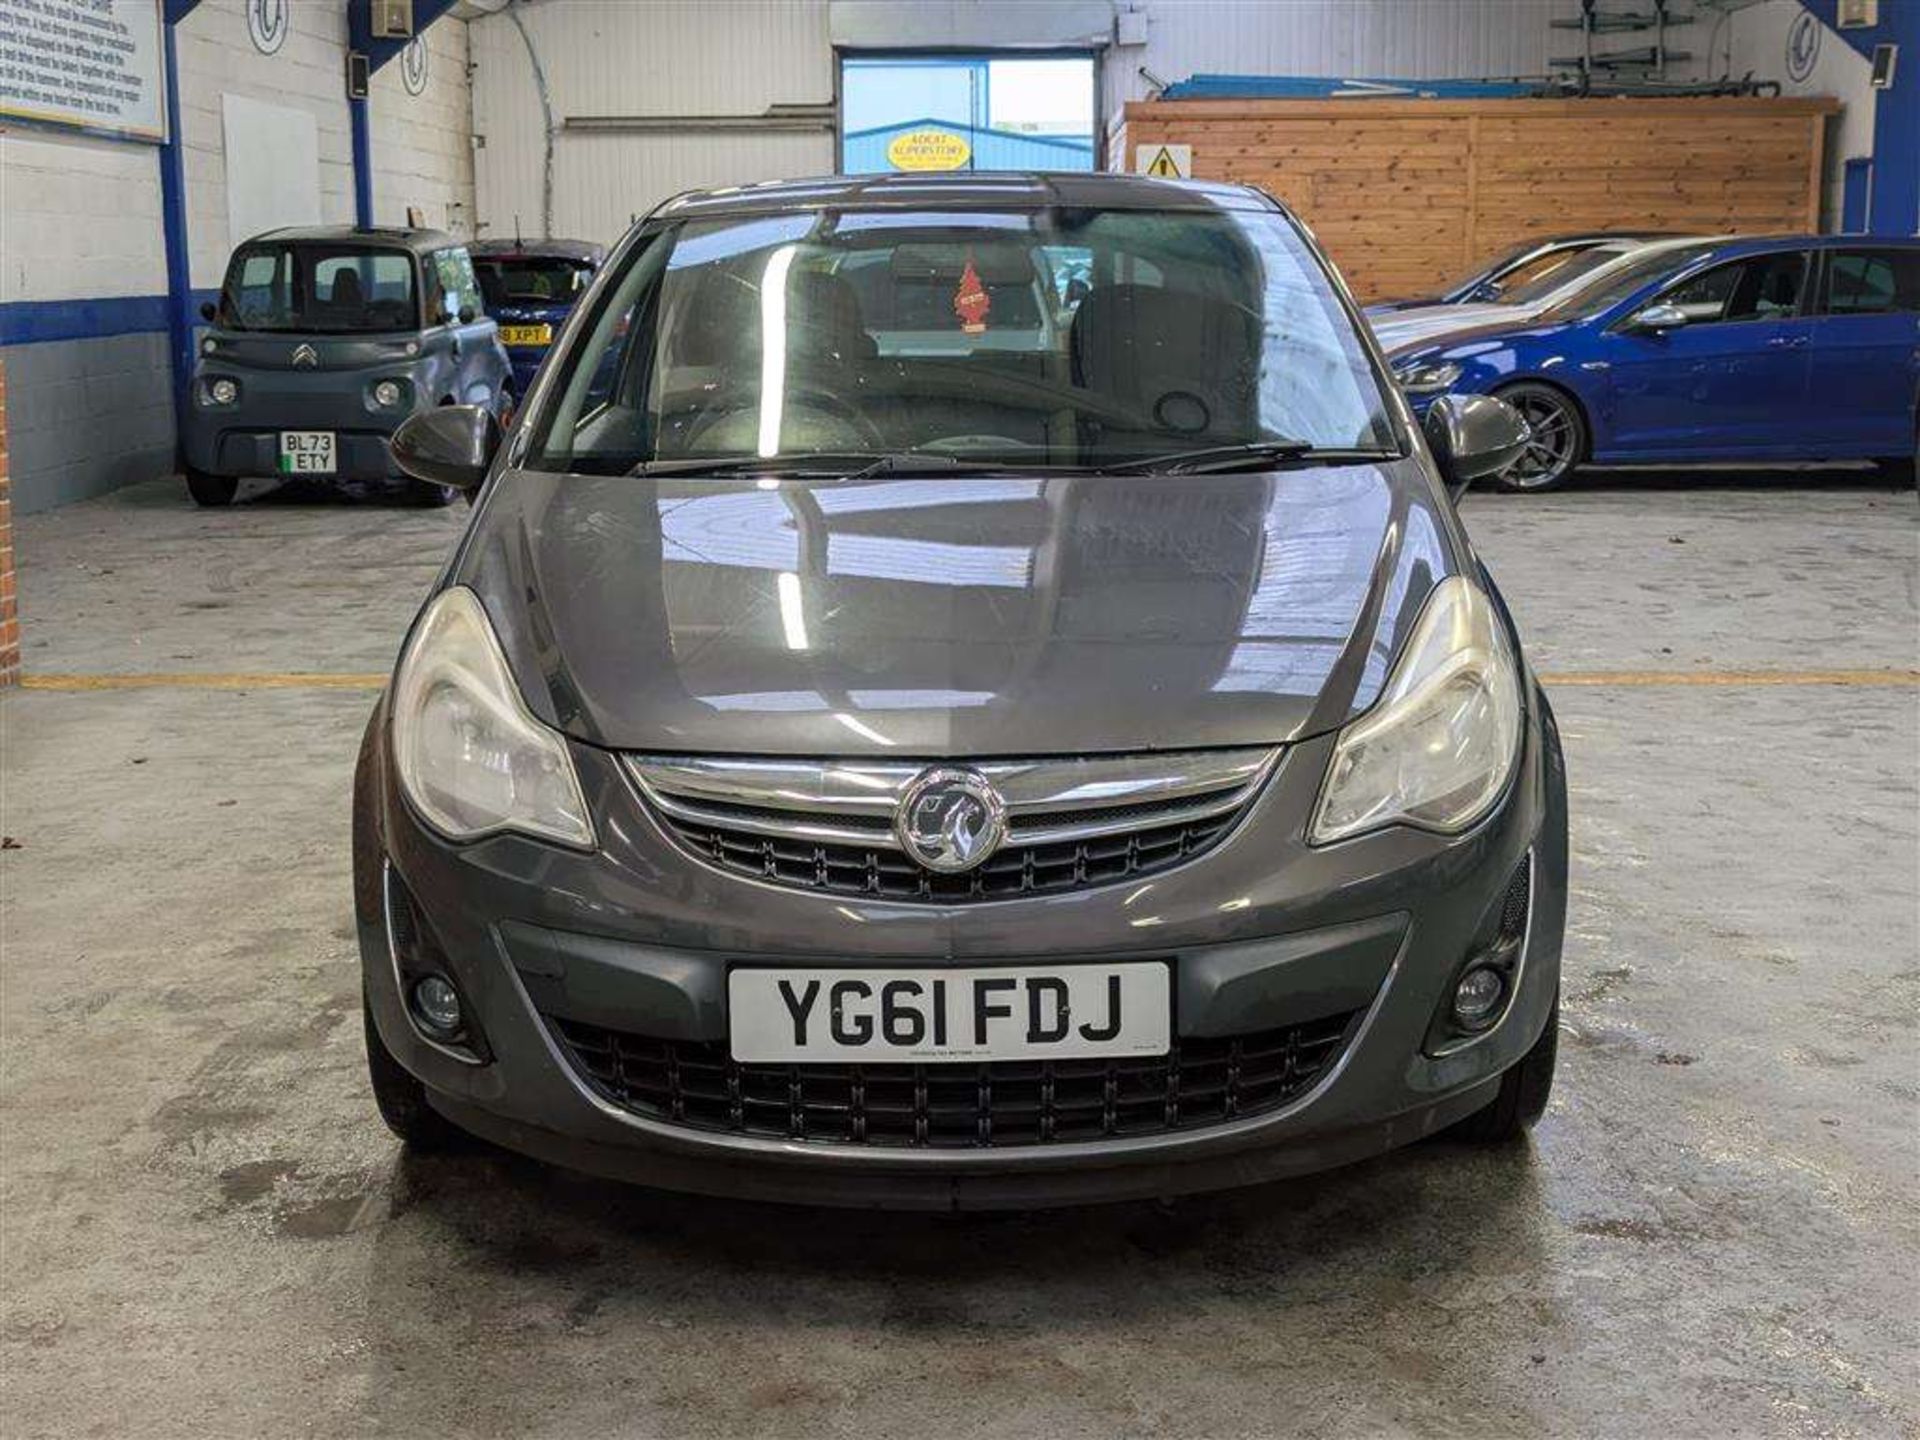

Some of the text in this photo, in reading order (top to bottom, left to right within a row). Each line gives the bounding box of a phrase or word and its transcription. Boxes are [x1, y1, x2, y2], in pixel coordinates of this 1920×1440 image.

[287, 435, 331, 451] BL73
[297, 453, 330, 469] ETY
[778, 975, 1122, 1046] YG61 FDJ
